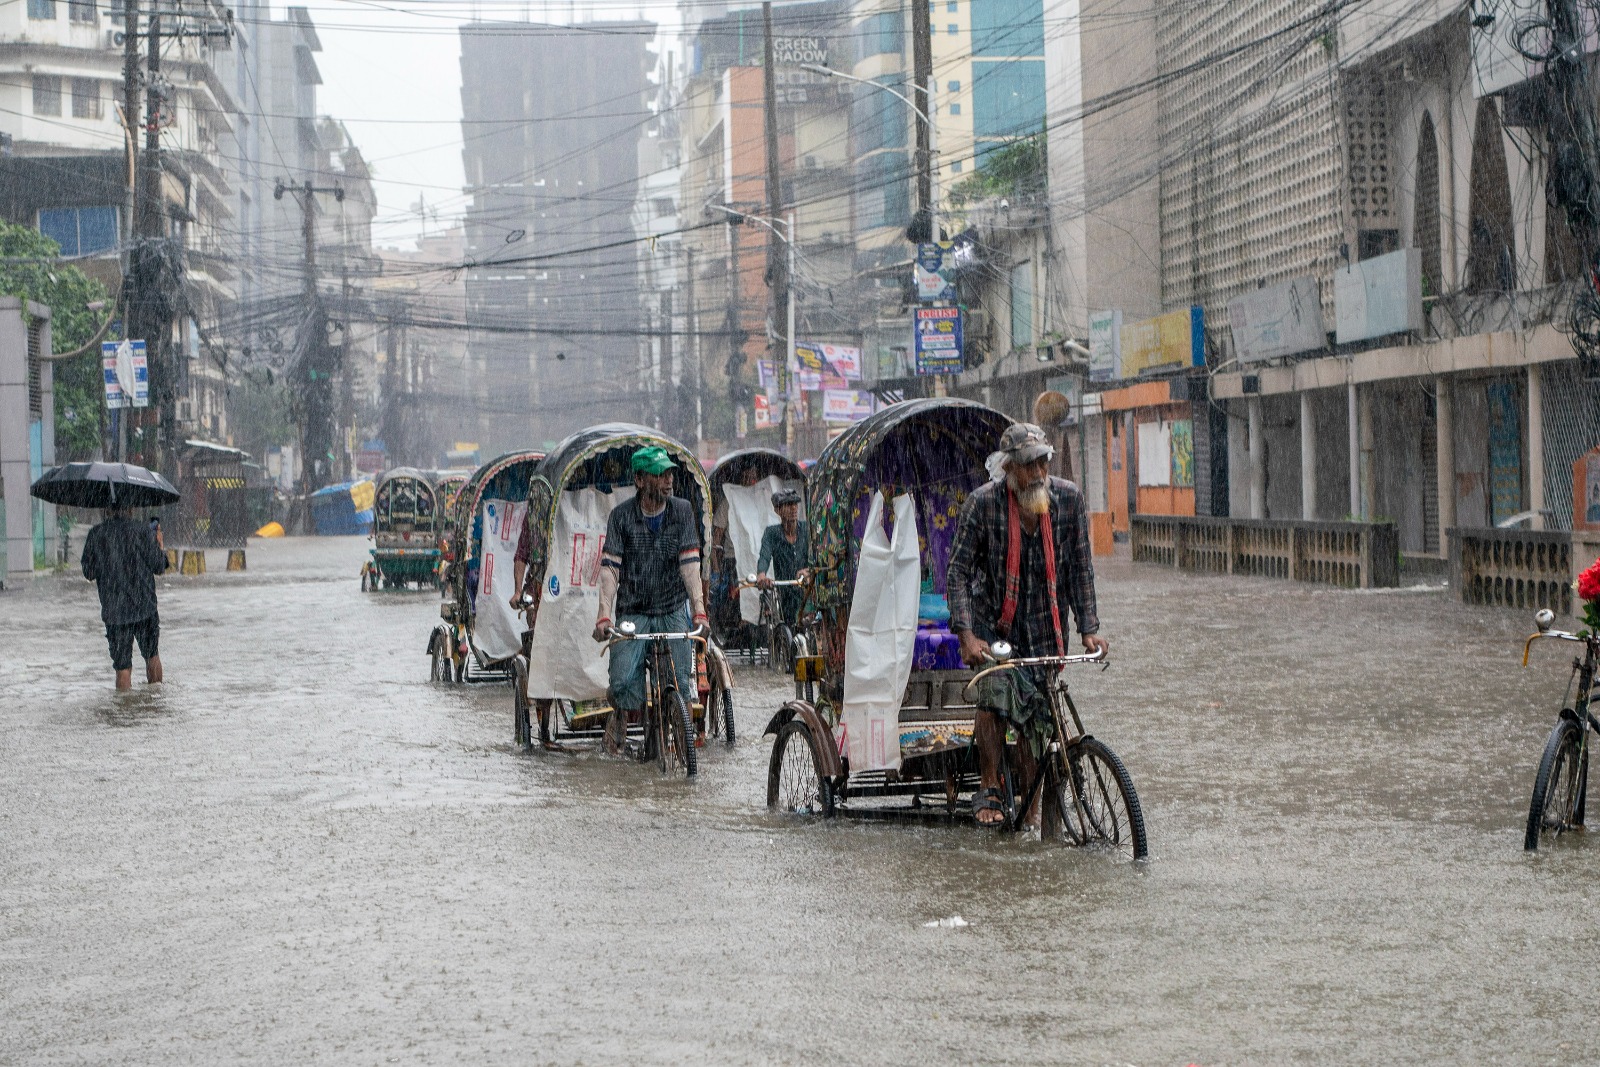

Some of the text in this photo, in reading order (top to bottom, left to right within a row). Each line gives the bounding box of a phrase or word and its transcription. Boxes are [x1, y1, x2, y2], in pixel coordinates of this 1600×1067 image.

[774, 38, 818, 50] GREEN
[772, 50, 827, 61] HADOW
[918, 308, 957, 318] ENGLISH
